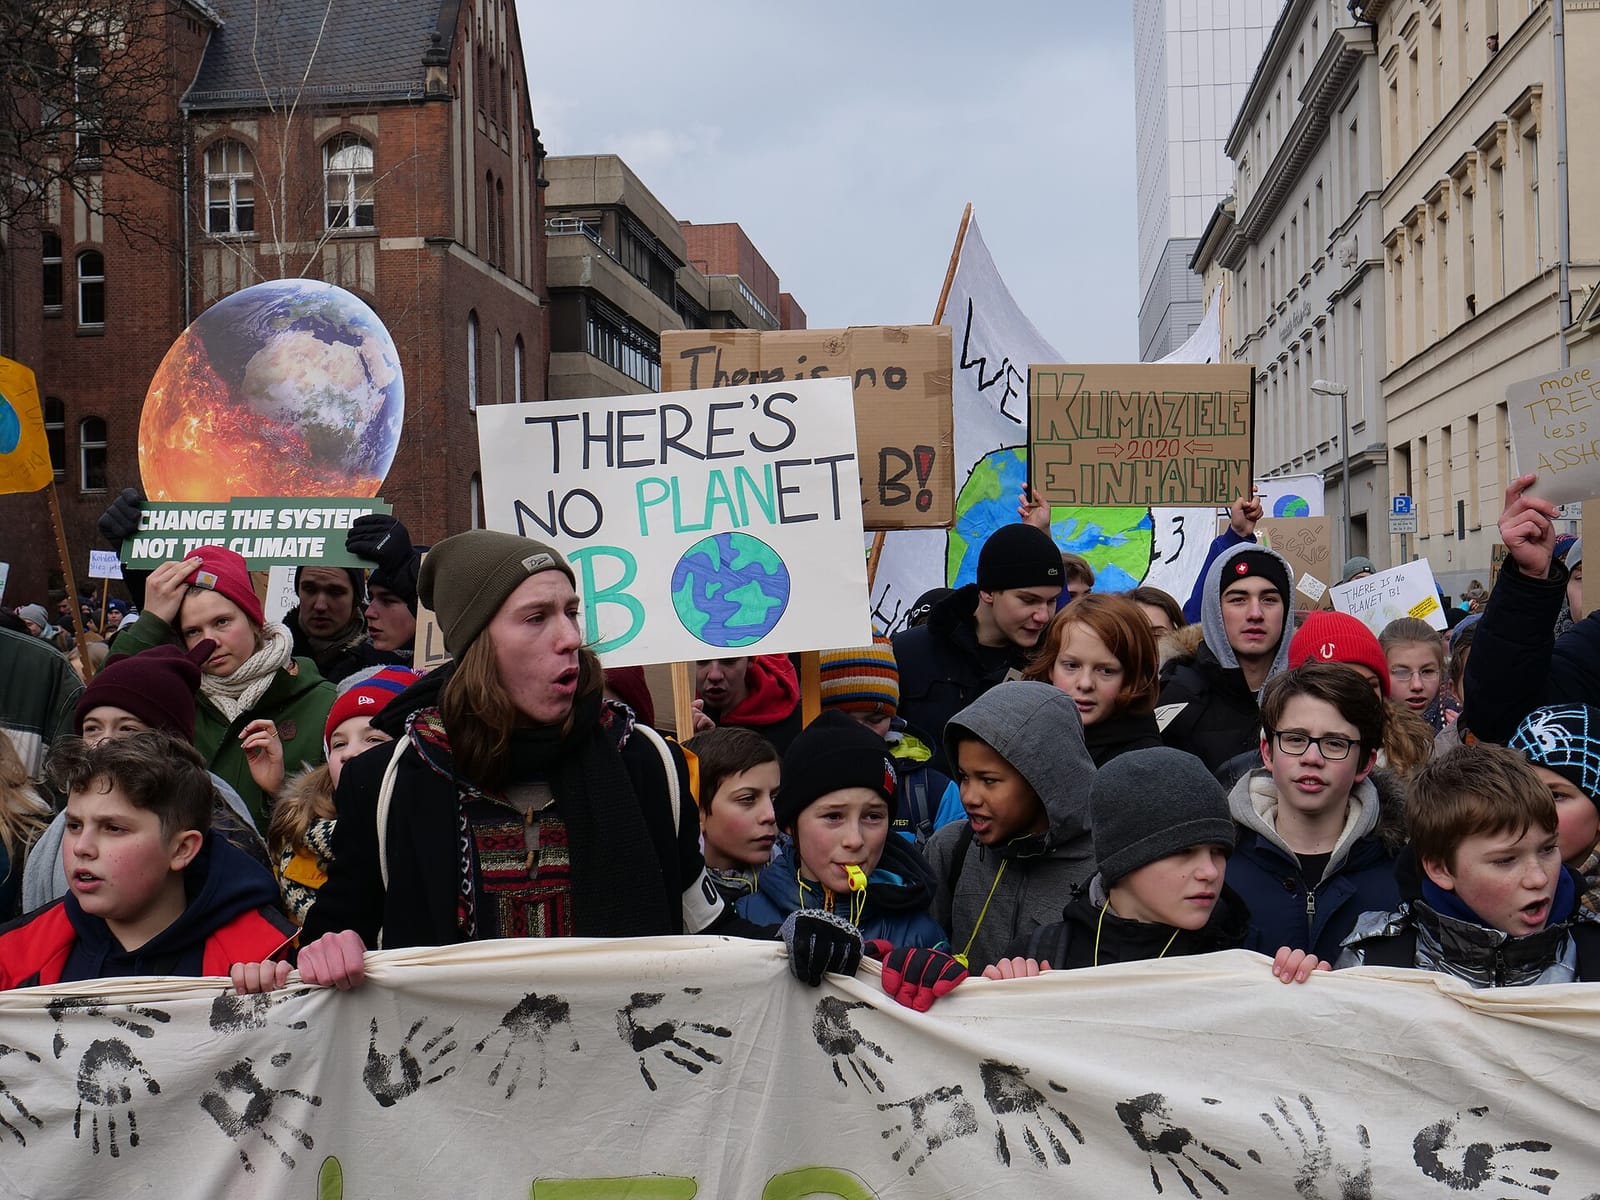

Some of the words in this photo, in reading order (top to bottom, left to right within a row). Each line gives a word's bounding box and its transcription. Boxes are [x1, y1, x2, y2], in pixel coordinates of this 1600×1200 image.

[960, 296, 1024, 424] WE
[854, 366, 908, 391] no
[1540, 368, 1592, 395] more
[1036, 372, 1250, 441] KLIMAZIELE
[525, 392, 798, 474] THERE'S
[1543, 421, 1588, 439] less
[1127, 438, 1180, 460] 2020
[877, 444, 936, 513] B!
[1032, 442, 1250, 505] EINHALTEN
[513, 488, 604, 538] NO
[635, 453, 855, 537] PLANET
[137, 509, 228, 531] CHANGE
[231, 508, 275, 530] THE
[131, 538, 179, 559] NOT
[229, 537, 326, 558] CLIMATE
[566, 545, 646, 654] B
[1341, 581, 1377, 604] THERE
[1380, 576, 1390, 589] IS
[1348, 592, 1383, 616] PLANET
